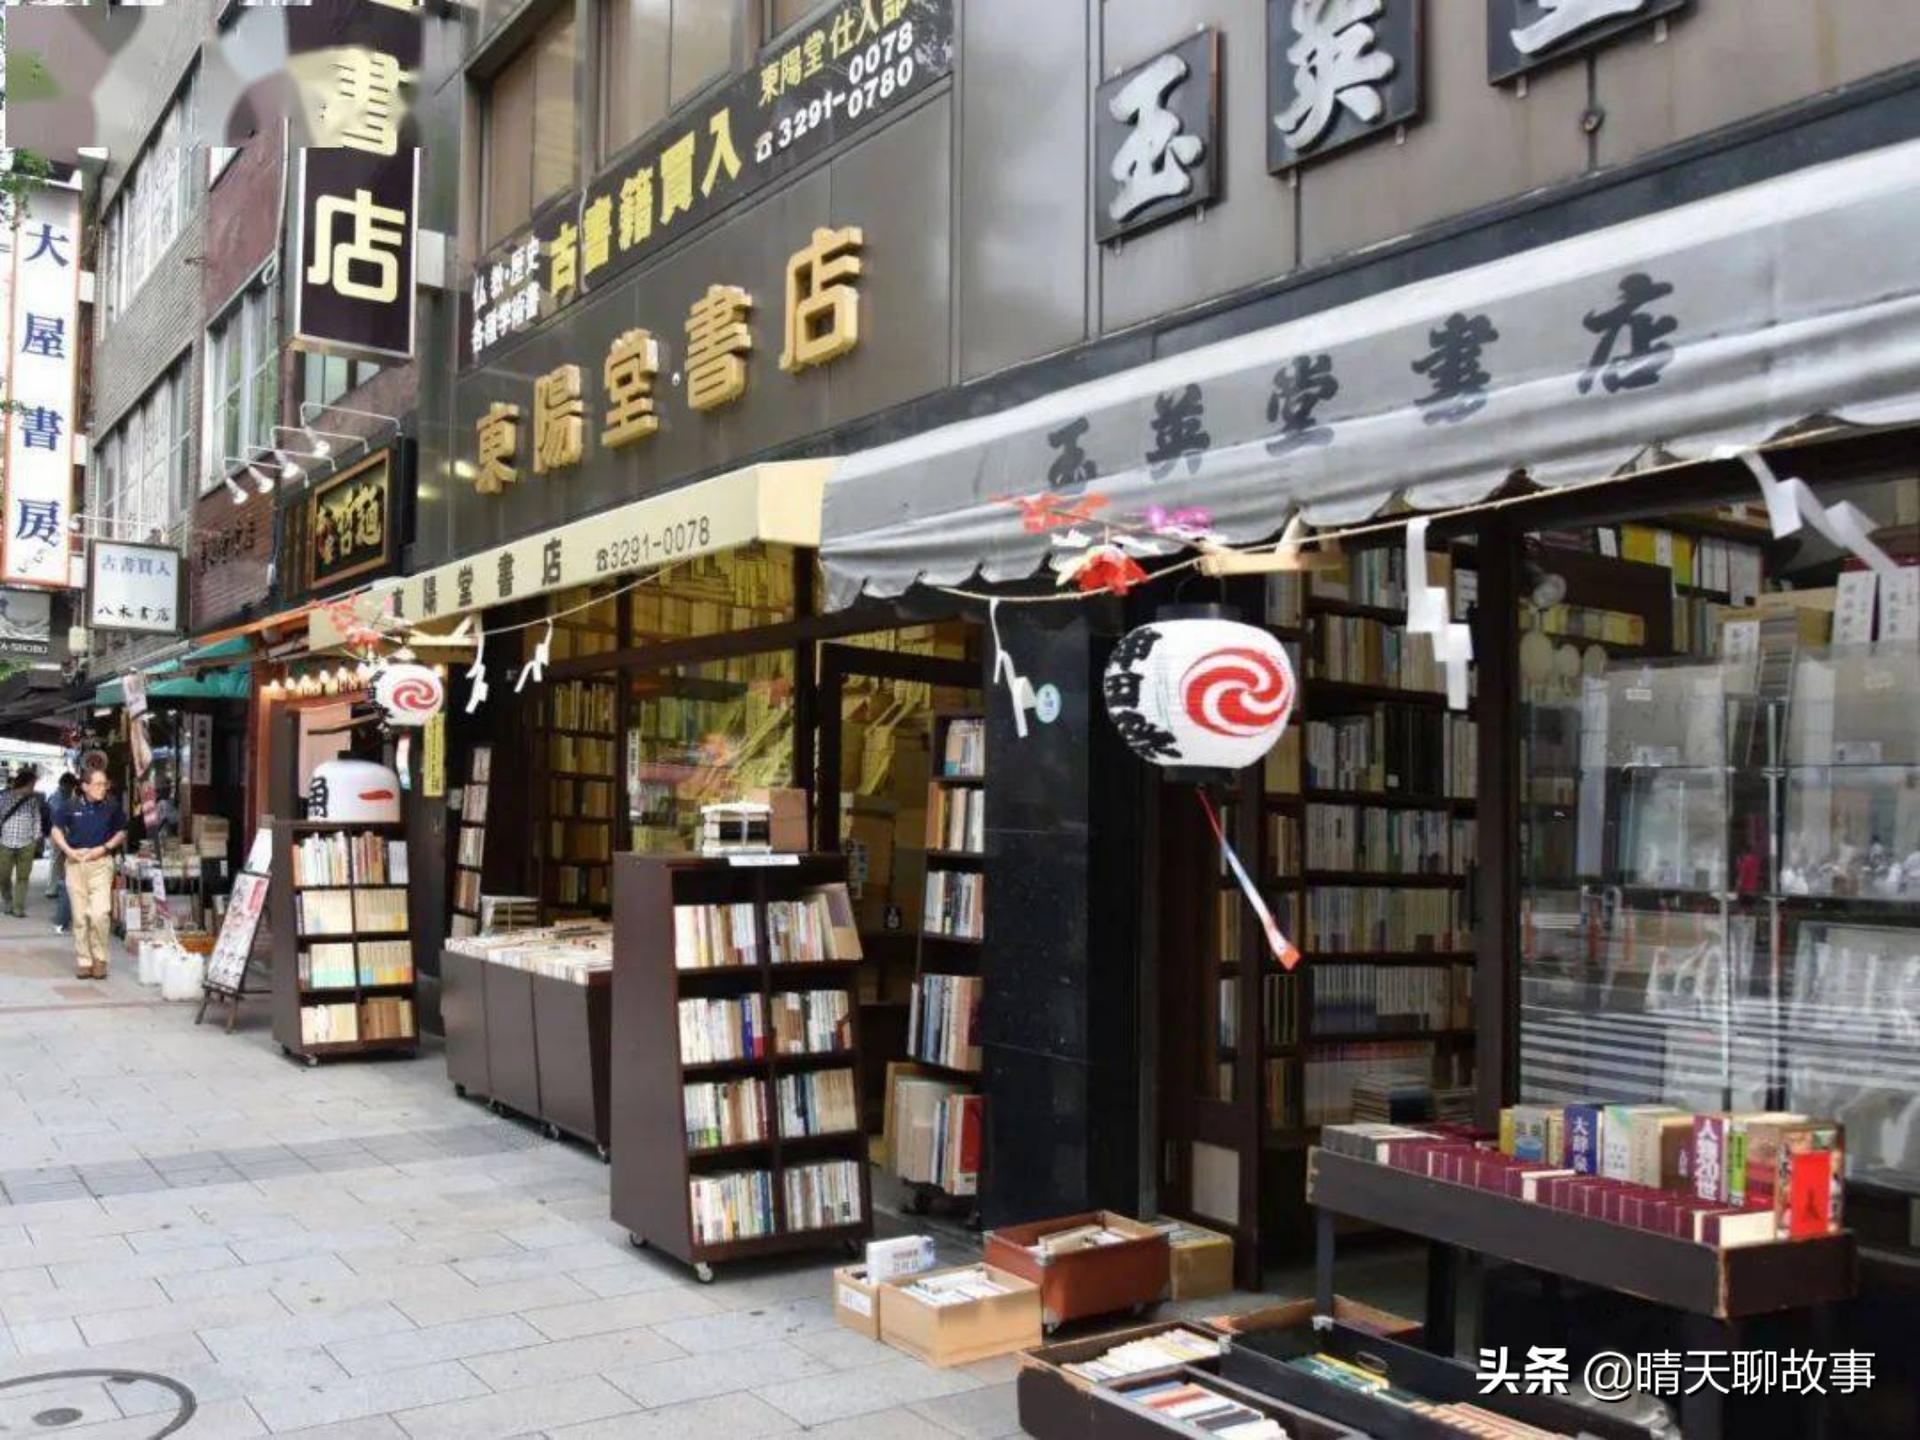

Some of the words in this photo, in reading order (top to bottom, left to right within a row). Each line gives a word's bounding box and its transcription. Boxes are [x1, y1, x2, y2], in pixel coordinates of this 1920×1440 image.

[759, 28, 826, 107] 東陽堂
[848, 56, 913, 118] 0780
[849, 21, 913, 84] 0078
[1108, 0, 1645, 224] 玉英
[550, 107, 741, 298] 古書籍買入
[15, 222, 70, 547] 大屋書房
[1048, 273, 1678, 496] 玉英堂書店
[100, 555, 172, 577] 古書買入
[609, 515, 711, 571] 3291-0078
[98, 604, 171, 622] 八木書店
